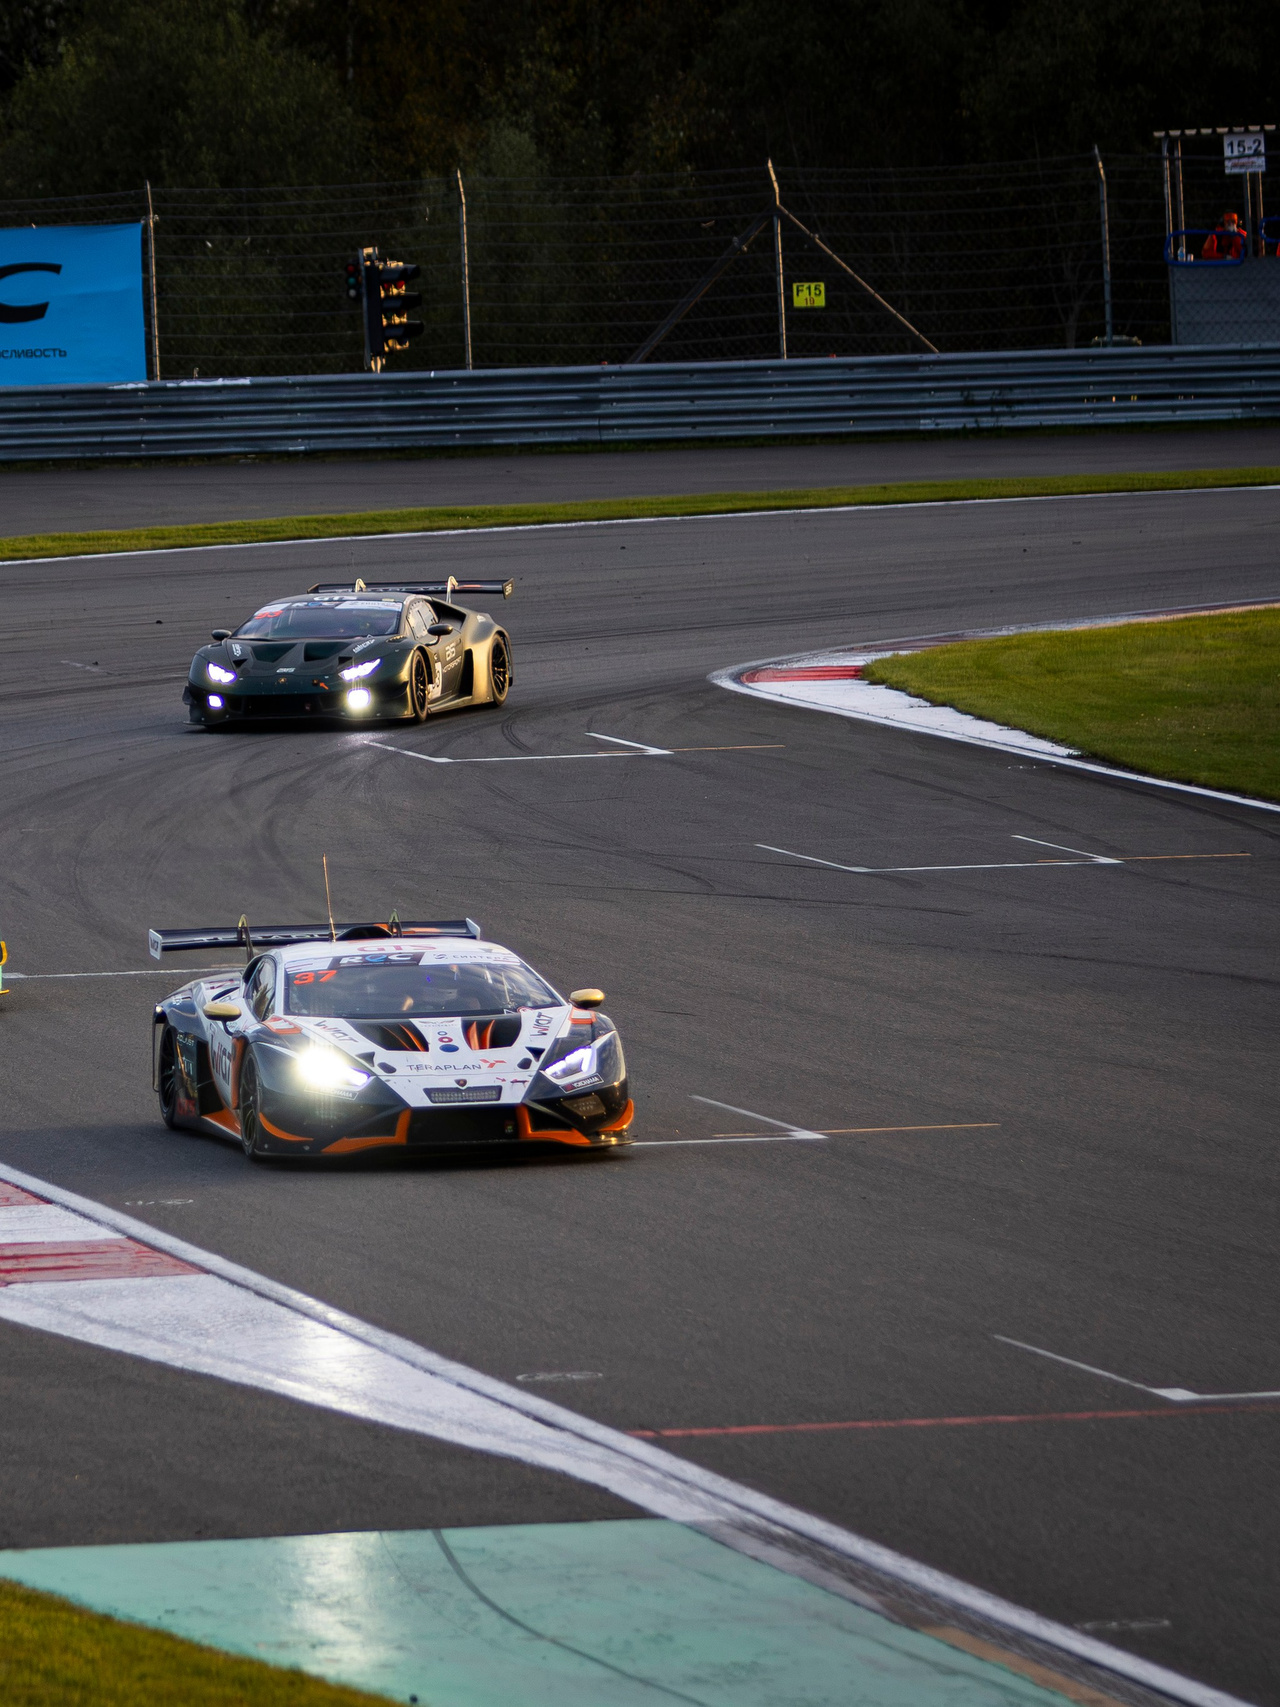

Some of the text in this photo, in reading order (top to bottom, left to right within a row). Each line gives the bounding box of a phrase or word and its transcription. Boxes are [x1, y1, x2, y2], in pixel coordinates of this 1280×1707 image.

[1226, 138, 1263, 155] 15-2
[293, 970, 338, 986] 37
[406, 1063, 482, 1072] TERAPLAN
[571, 1076, 601, 1089] YOKOHAMA
